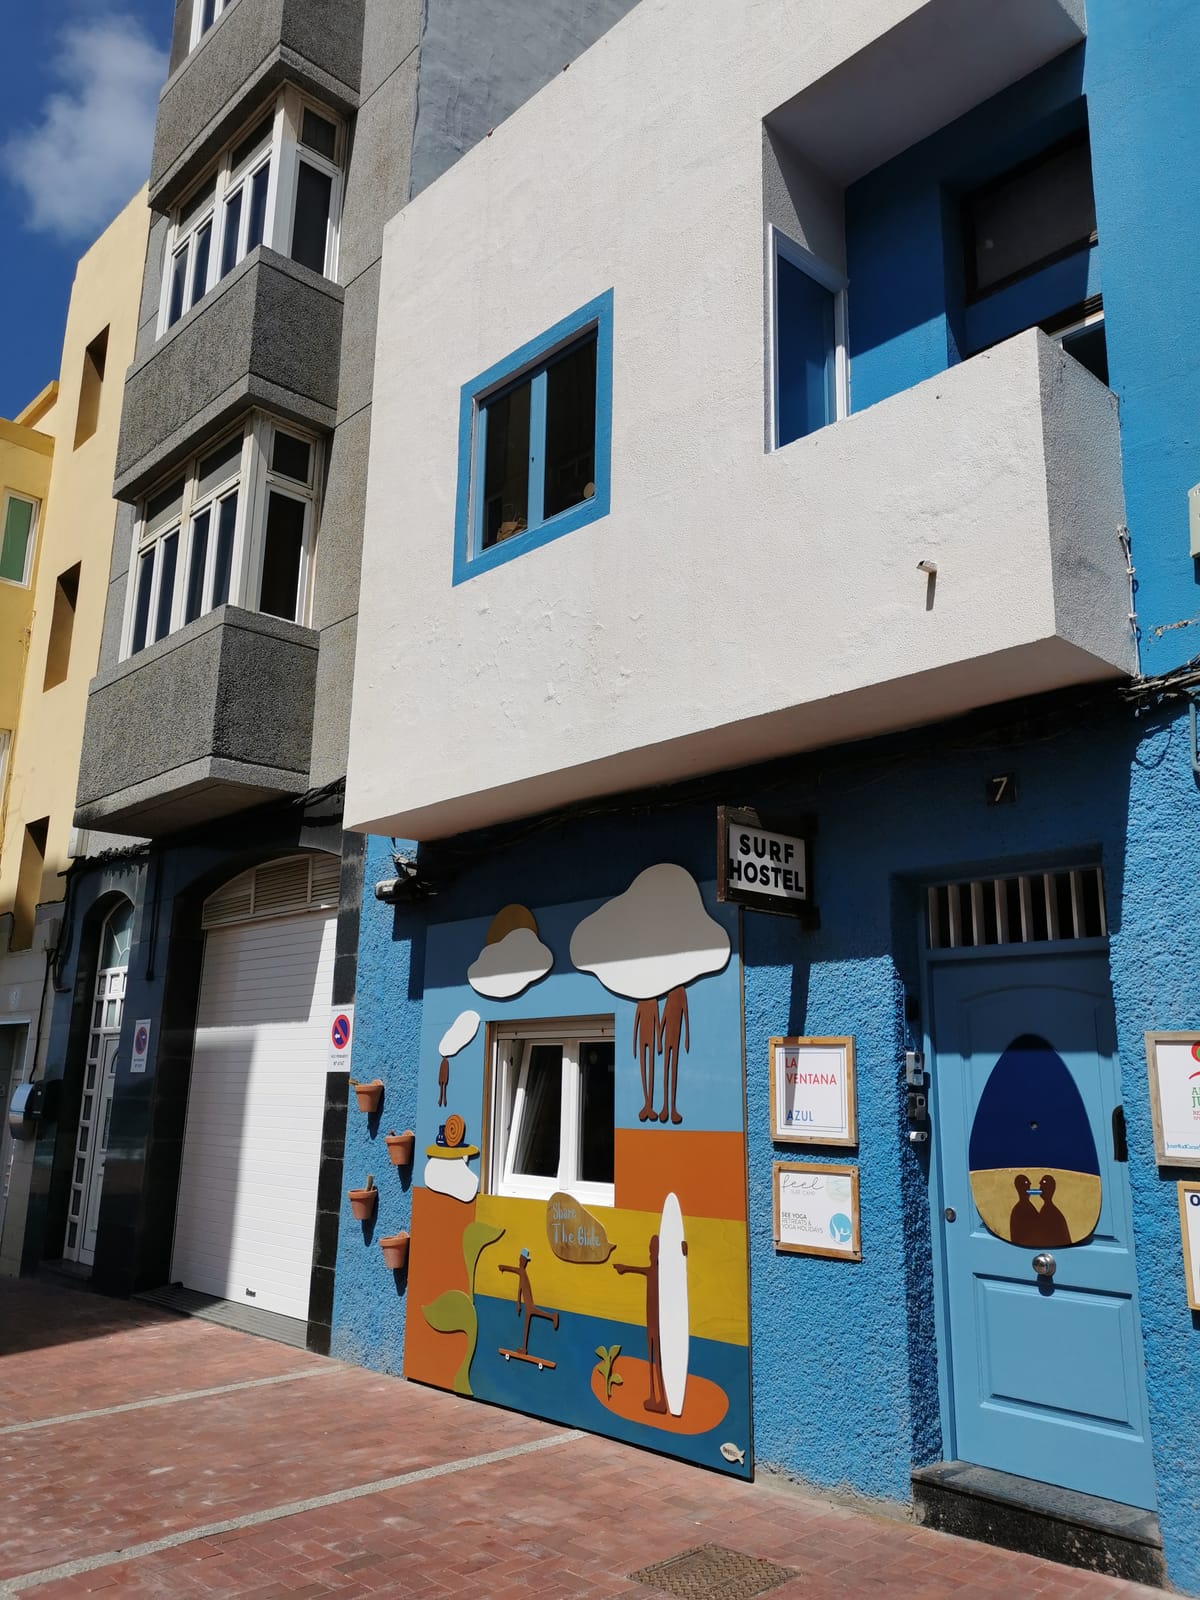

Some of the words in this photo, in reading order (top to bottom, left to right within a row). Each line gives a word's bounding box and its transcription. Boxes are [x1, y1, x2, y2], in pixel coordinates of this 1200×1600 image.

[993, 776, 1008, 802] 7
[739, 834, 794, 864] SURF
[729, 858, 804, 893] HOSTEL
[785, 1057, 798, 1069] LA
[786, 1072, 837, 1086] VENTANA
[786, 1109, 814, 1122] AZUL
[782, 1174, 825, 1193] feel
[552, 1200, 577, 1221] Share
[792, 1212, 808, 1220] YOGA
[551, 1223, 574, 1246] The
